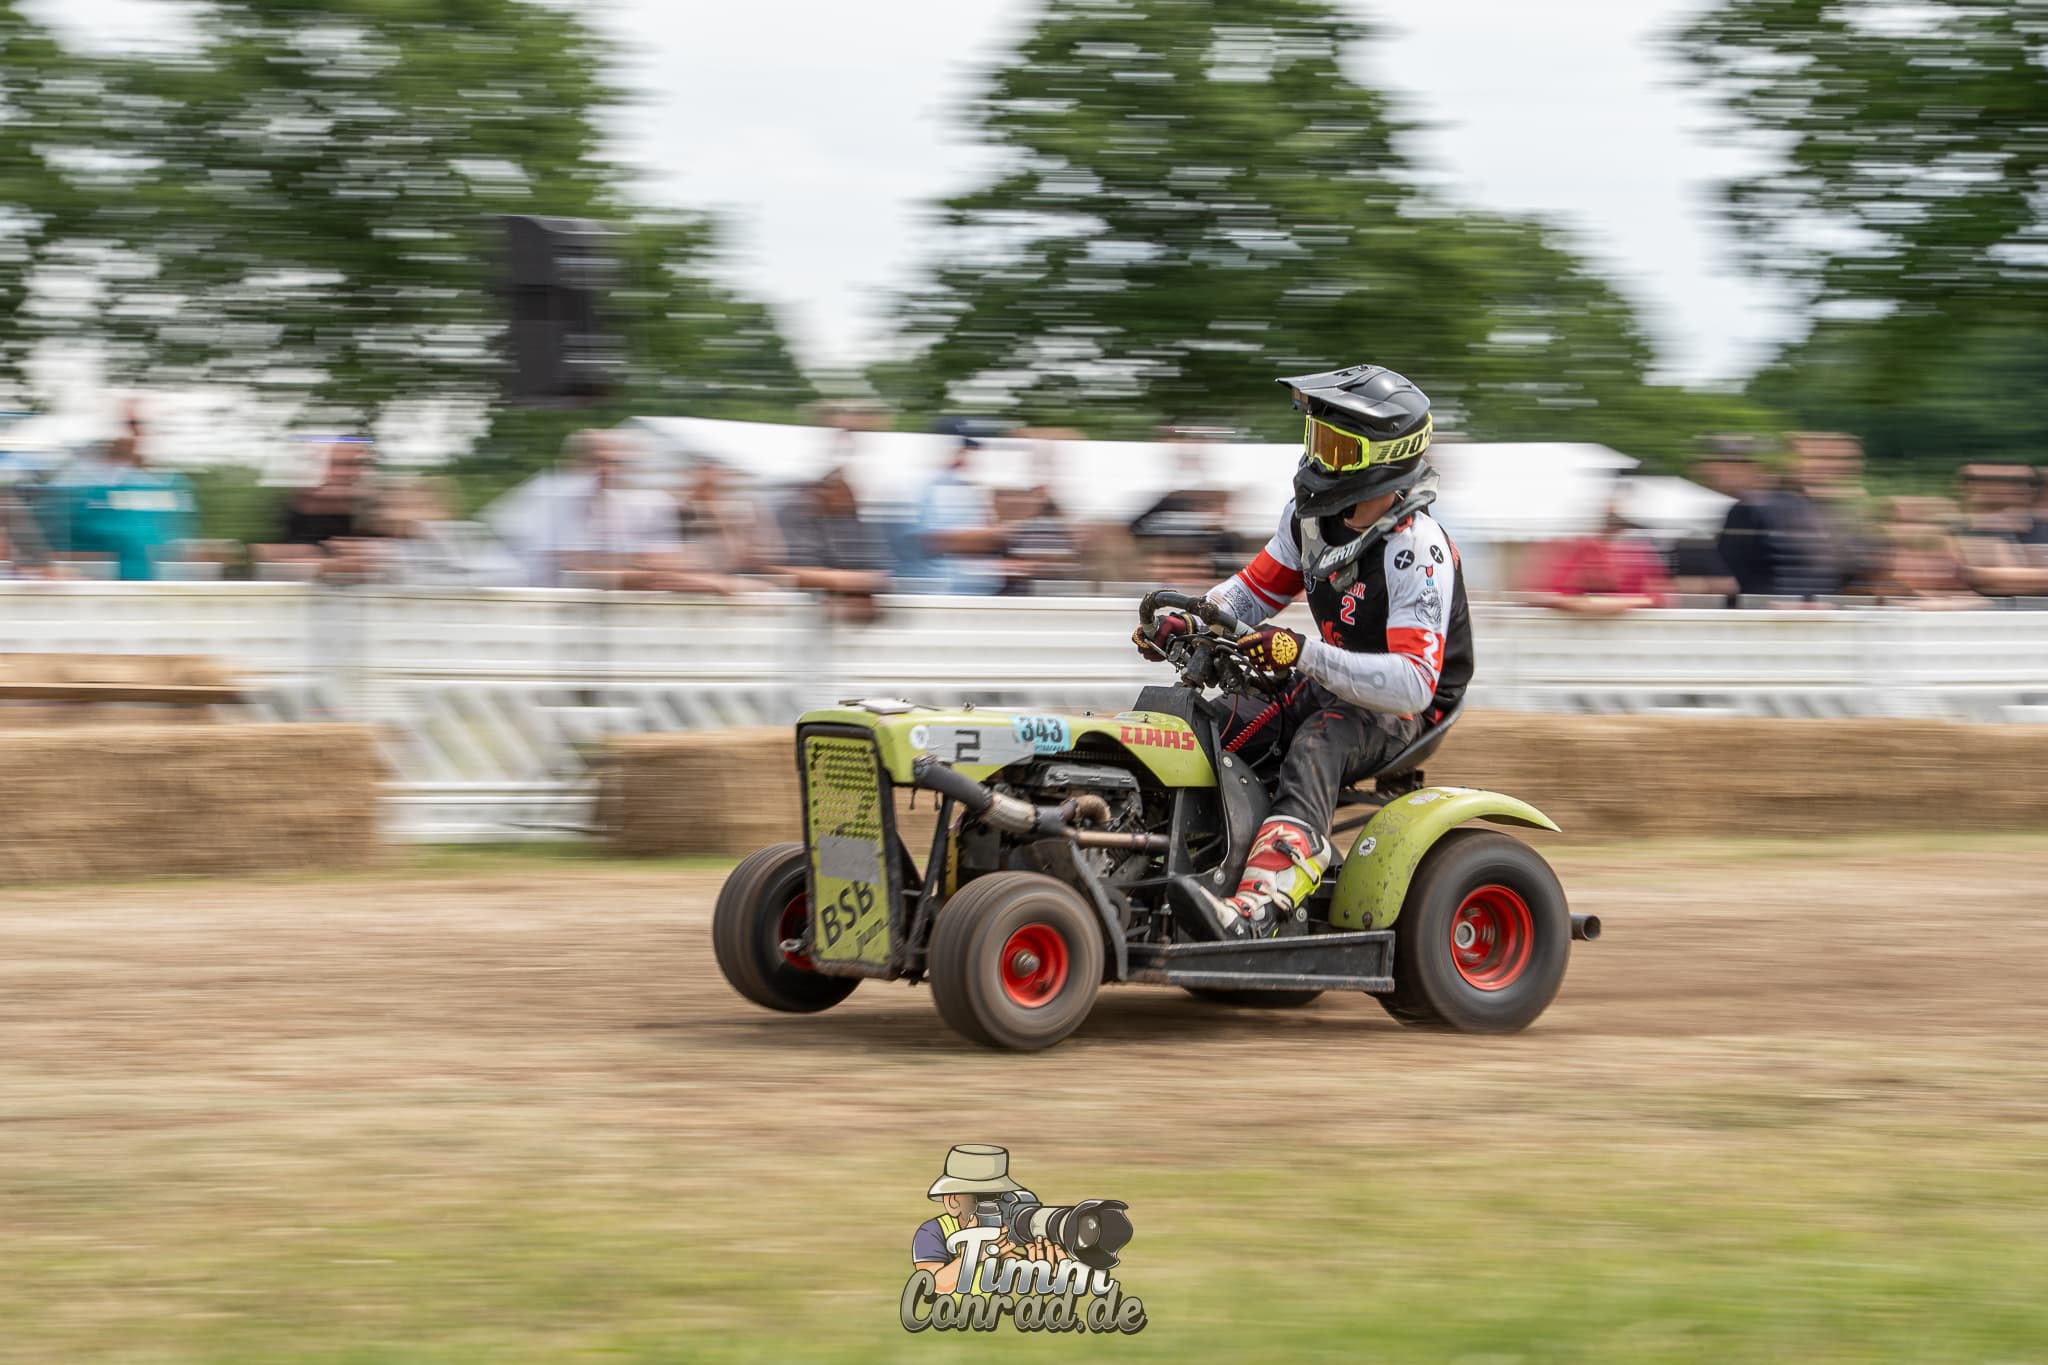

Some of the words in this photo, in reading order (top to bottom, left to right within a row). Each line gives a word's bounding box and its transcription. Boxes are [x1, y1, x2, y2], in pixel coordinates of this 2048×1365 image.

[1341, 595, 1356, 625] 2
[1018, 717, 1063, 743] 343
[1120, 726, 1195, 751] CLAAS
[955, 729, 980, 762] 2
